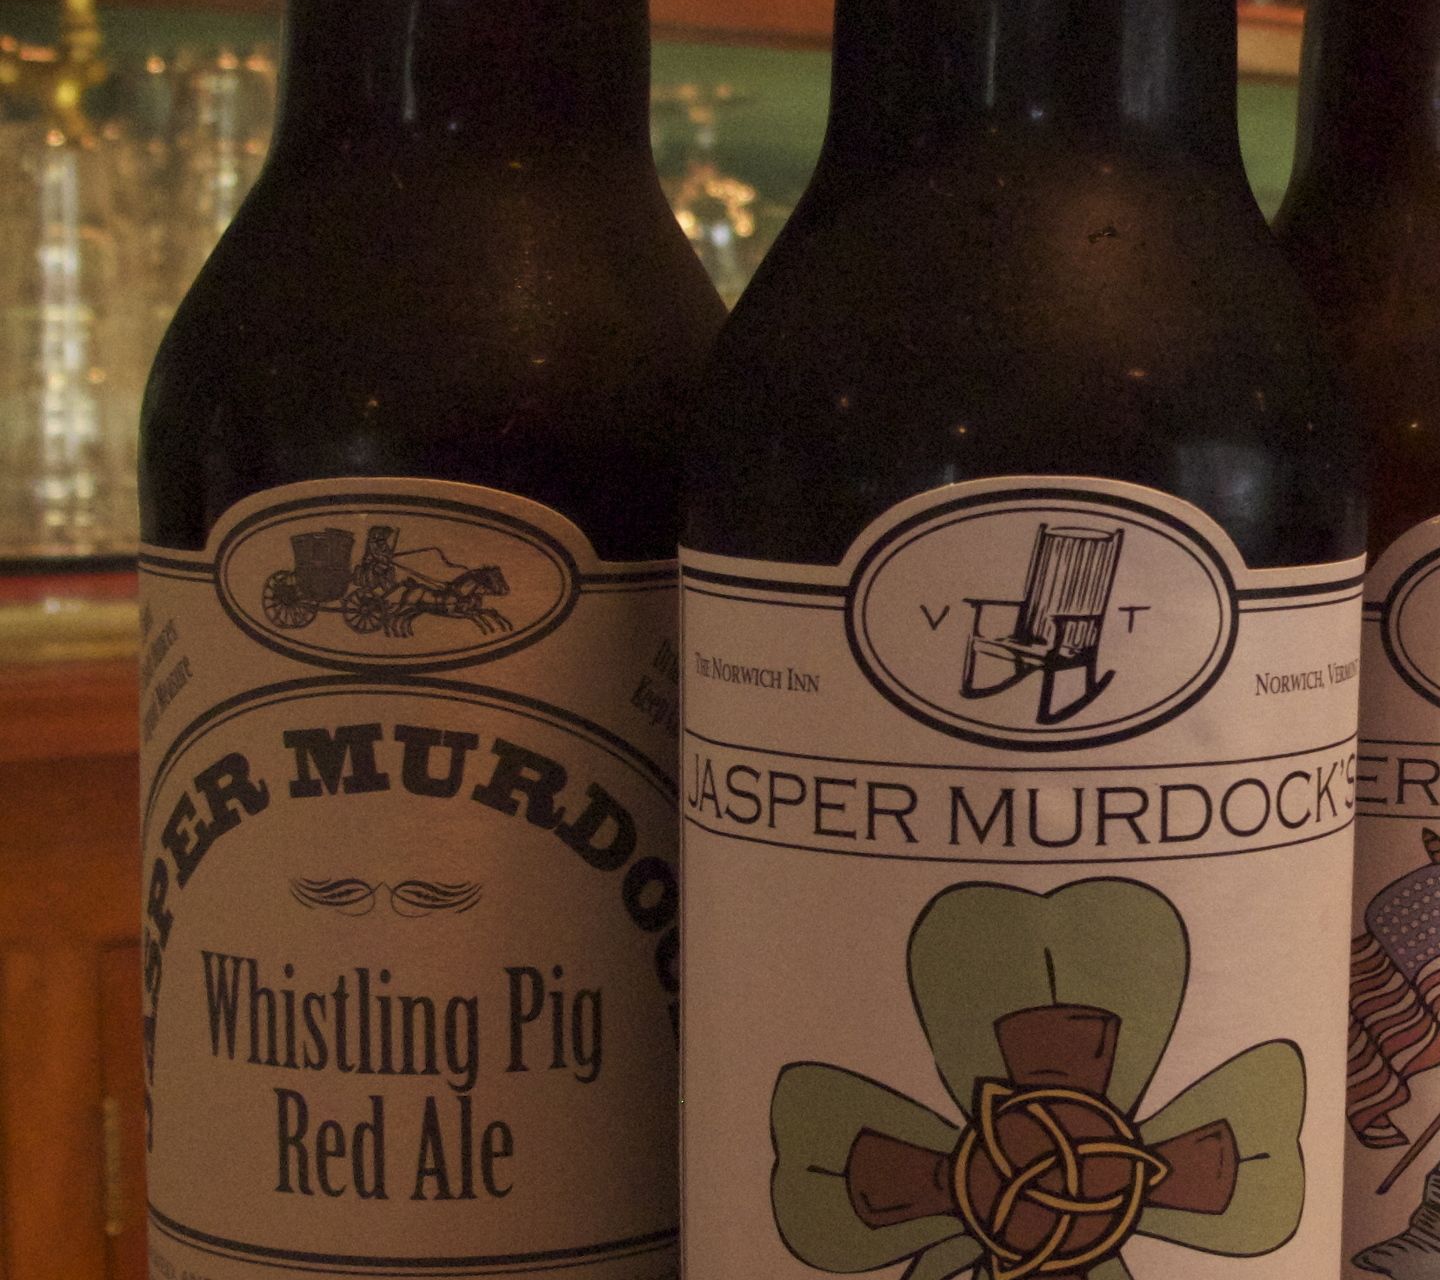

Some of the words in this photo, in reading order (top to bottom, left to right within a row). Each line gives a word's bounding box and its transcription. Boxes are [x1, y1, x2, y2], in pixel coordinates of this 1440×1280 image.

[712, 655, 782, 690] NORWICH
[786, 667, 820, 693] INN
[686, 753, 919, 844] JASPER
[947, 751, 1356, 849] MURDOCK'S
[201, 949, 479, 1093] Whistling
[504, 963, 603, 1084] Pig
[272, 1087, 390, 1200] Red
[409, 1094, 515, 1201] Ale
